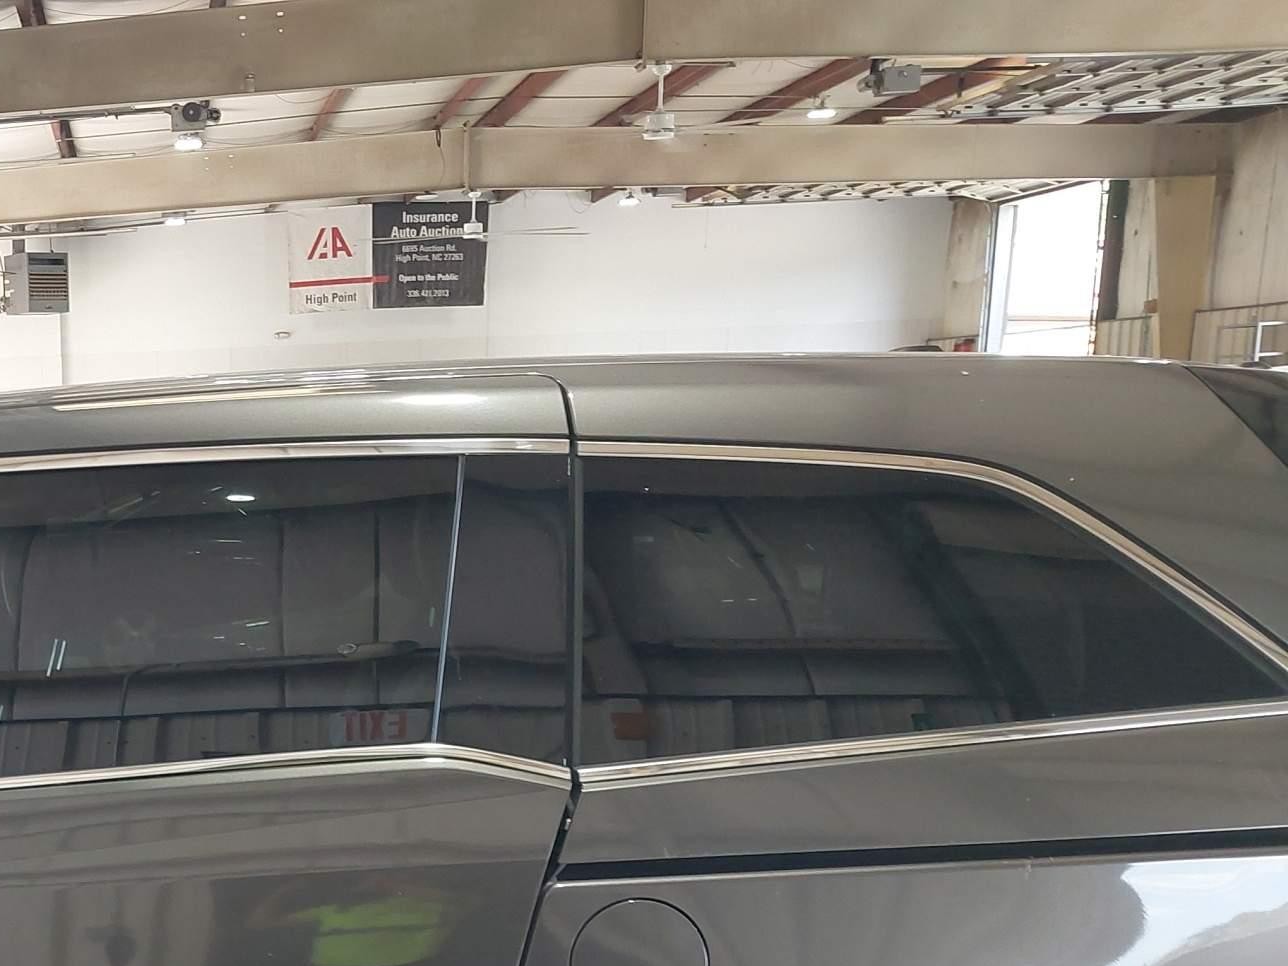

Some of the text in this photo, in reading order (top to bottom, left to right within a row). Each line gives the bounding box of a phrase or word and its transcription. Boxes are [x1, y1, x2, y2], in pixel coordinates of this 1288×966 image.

[402, 211, 459, 224] Insurance
[391, 224, 465, 239] Auto Auction
[419, 244, 445, 252] Auction
[398, 274, 417, 283] Open
[437, 273, 459, 281] Public
[305, 291, 357, 306] High Point
